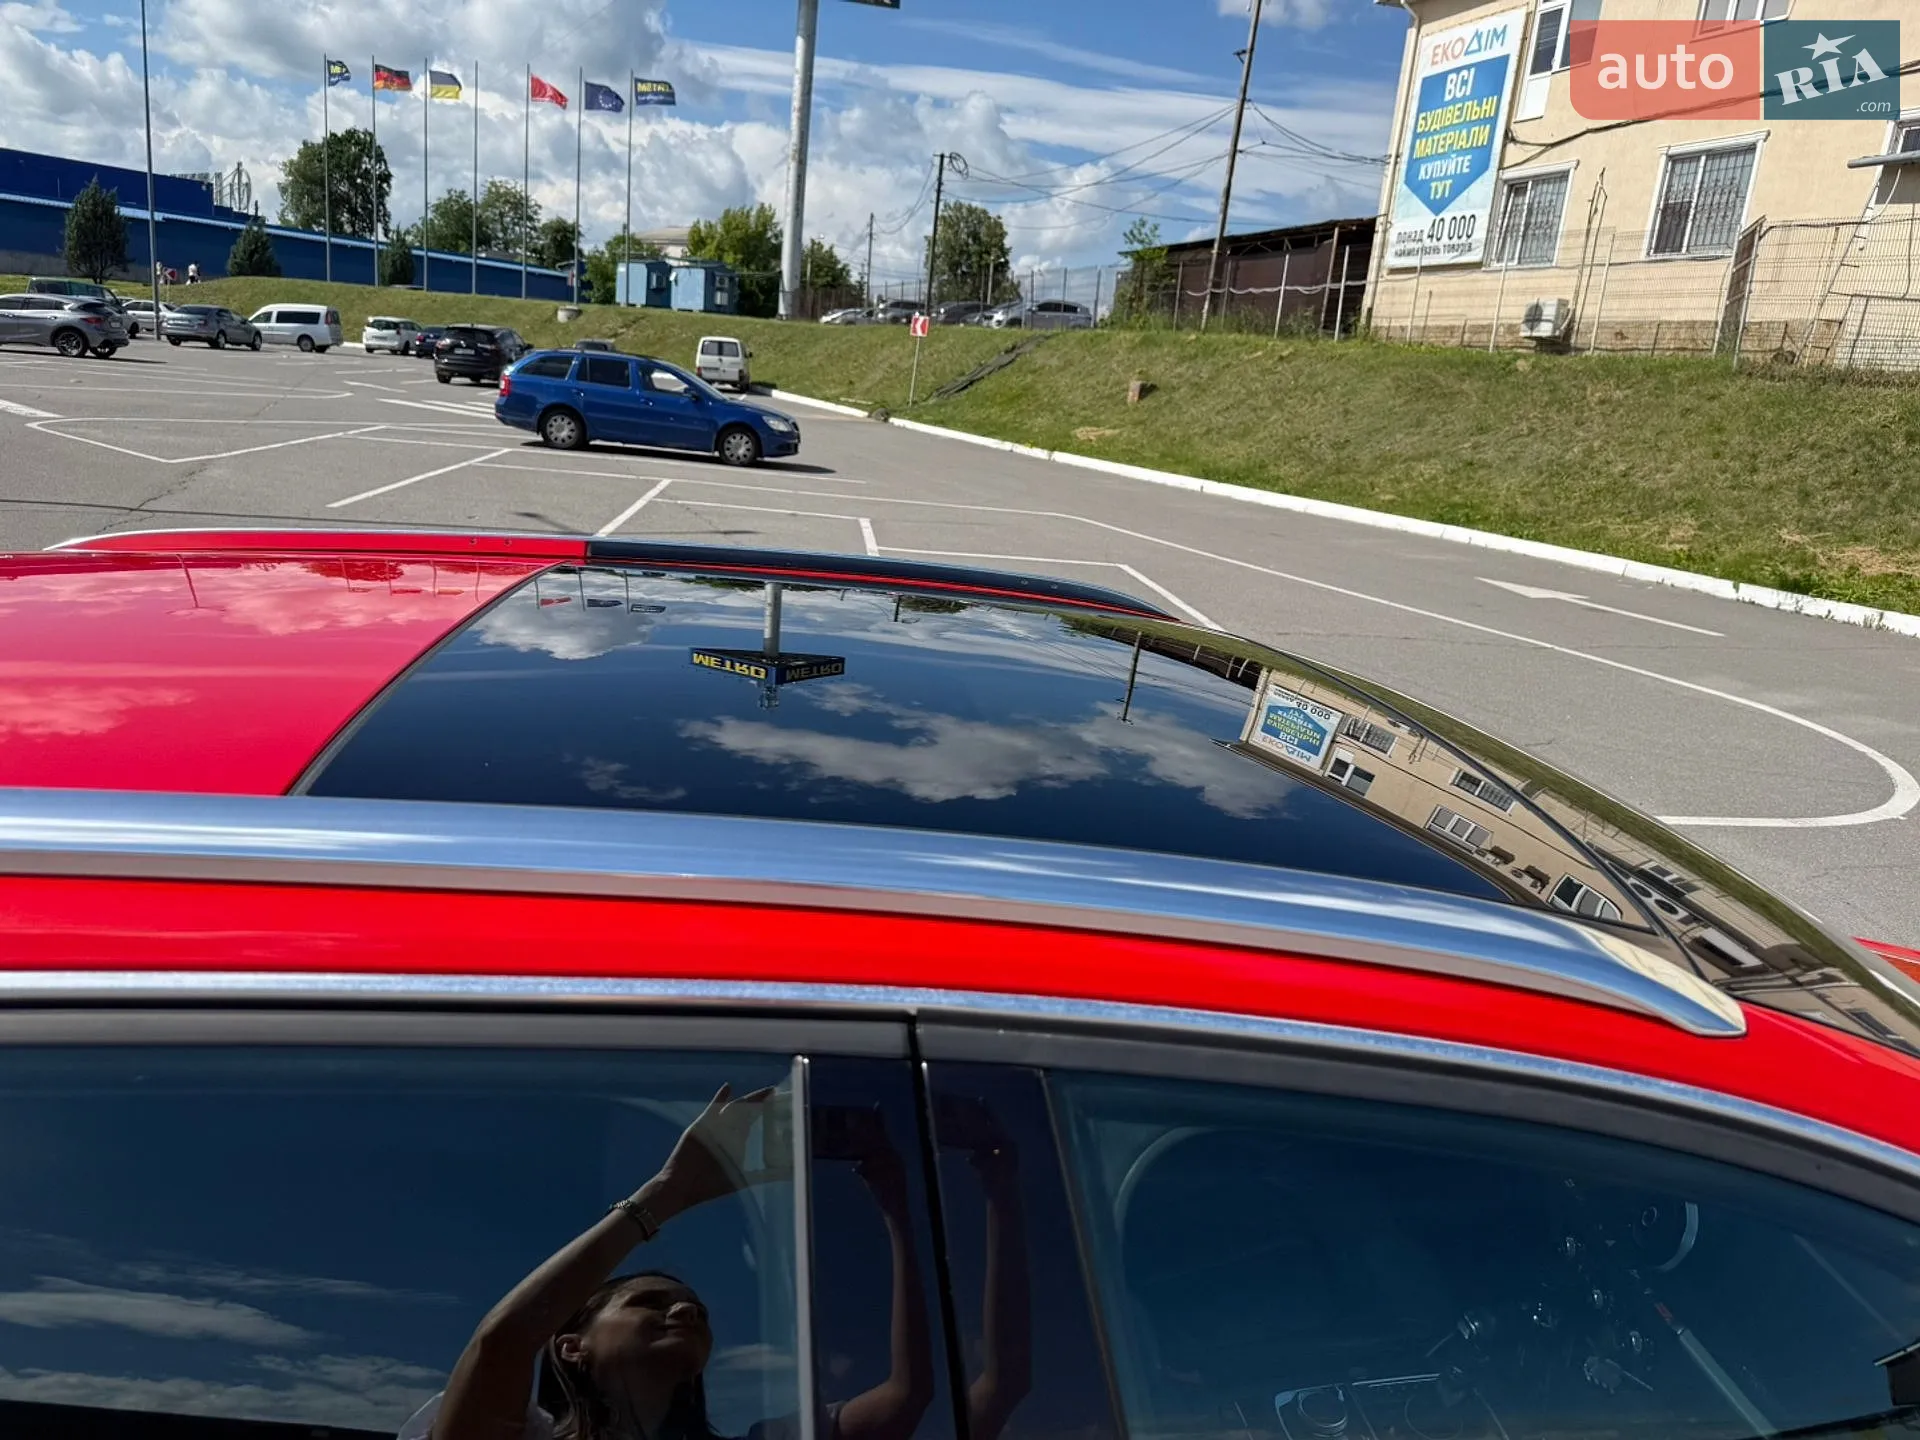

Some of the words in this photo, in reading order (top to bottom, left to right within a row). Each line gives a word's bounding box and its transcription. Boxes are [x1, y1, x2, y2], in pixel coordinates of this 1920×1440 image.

[1444, 67, 1475, 102] ВСІ
[1417, 95, 1498, 133] БУДІВЕЛЬНІ
[1413, 124, 1491, 159] МАТЕРІАЛИ
[1418, 154, 1472, 181] КУПУЙТЕ
[1430, 179, 1452, 200] ТУТ
[1427, 217, 1445, 243] 40
[1447, 214, 1476, 241] 000
